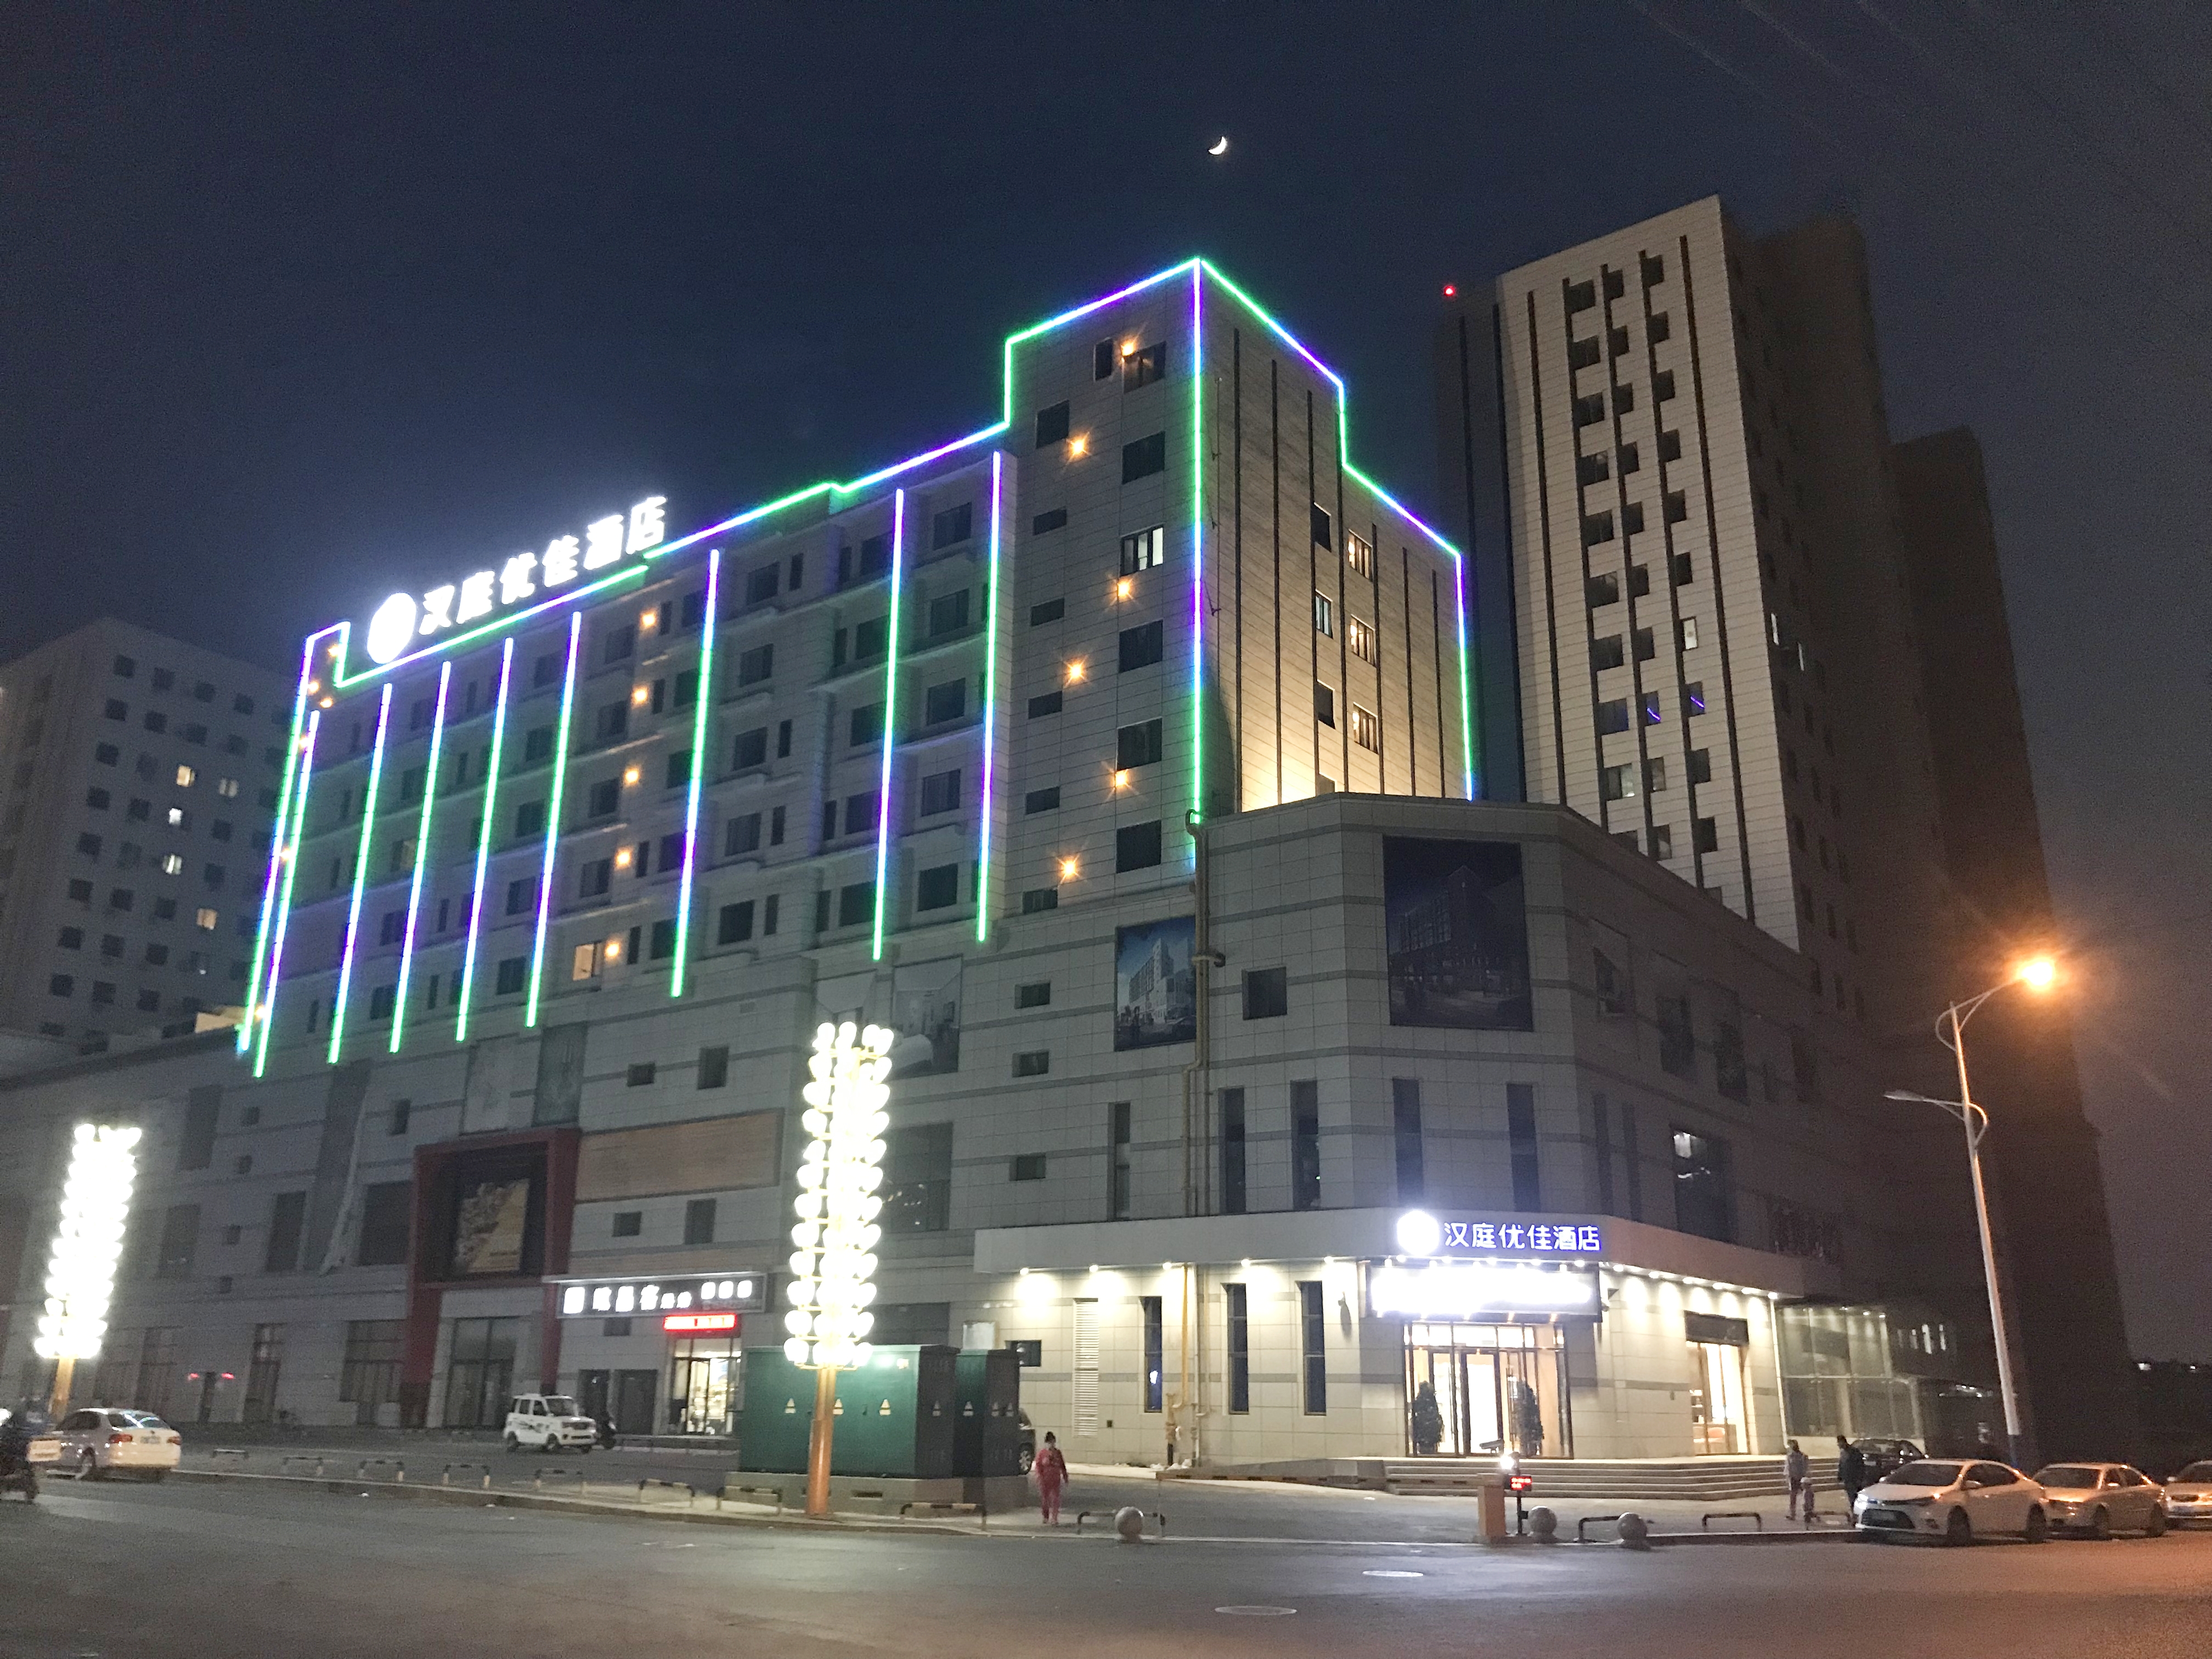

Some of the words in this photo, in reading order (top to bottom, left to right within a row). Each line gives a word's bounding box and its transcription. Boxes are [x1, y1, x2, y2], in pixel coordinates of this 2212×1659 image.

[1444, 1222, 1601, 1251] 汉庭优佳酒店
